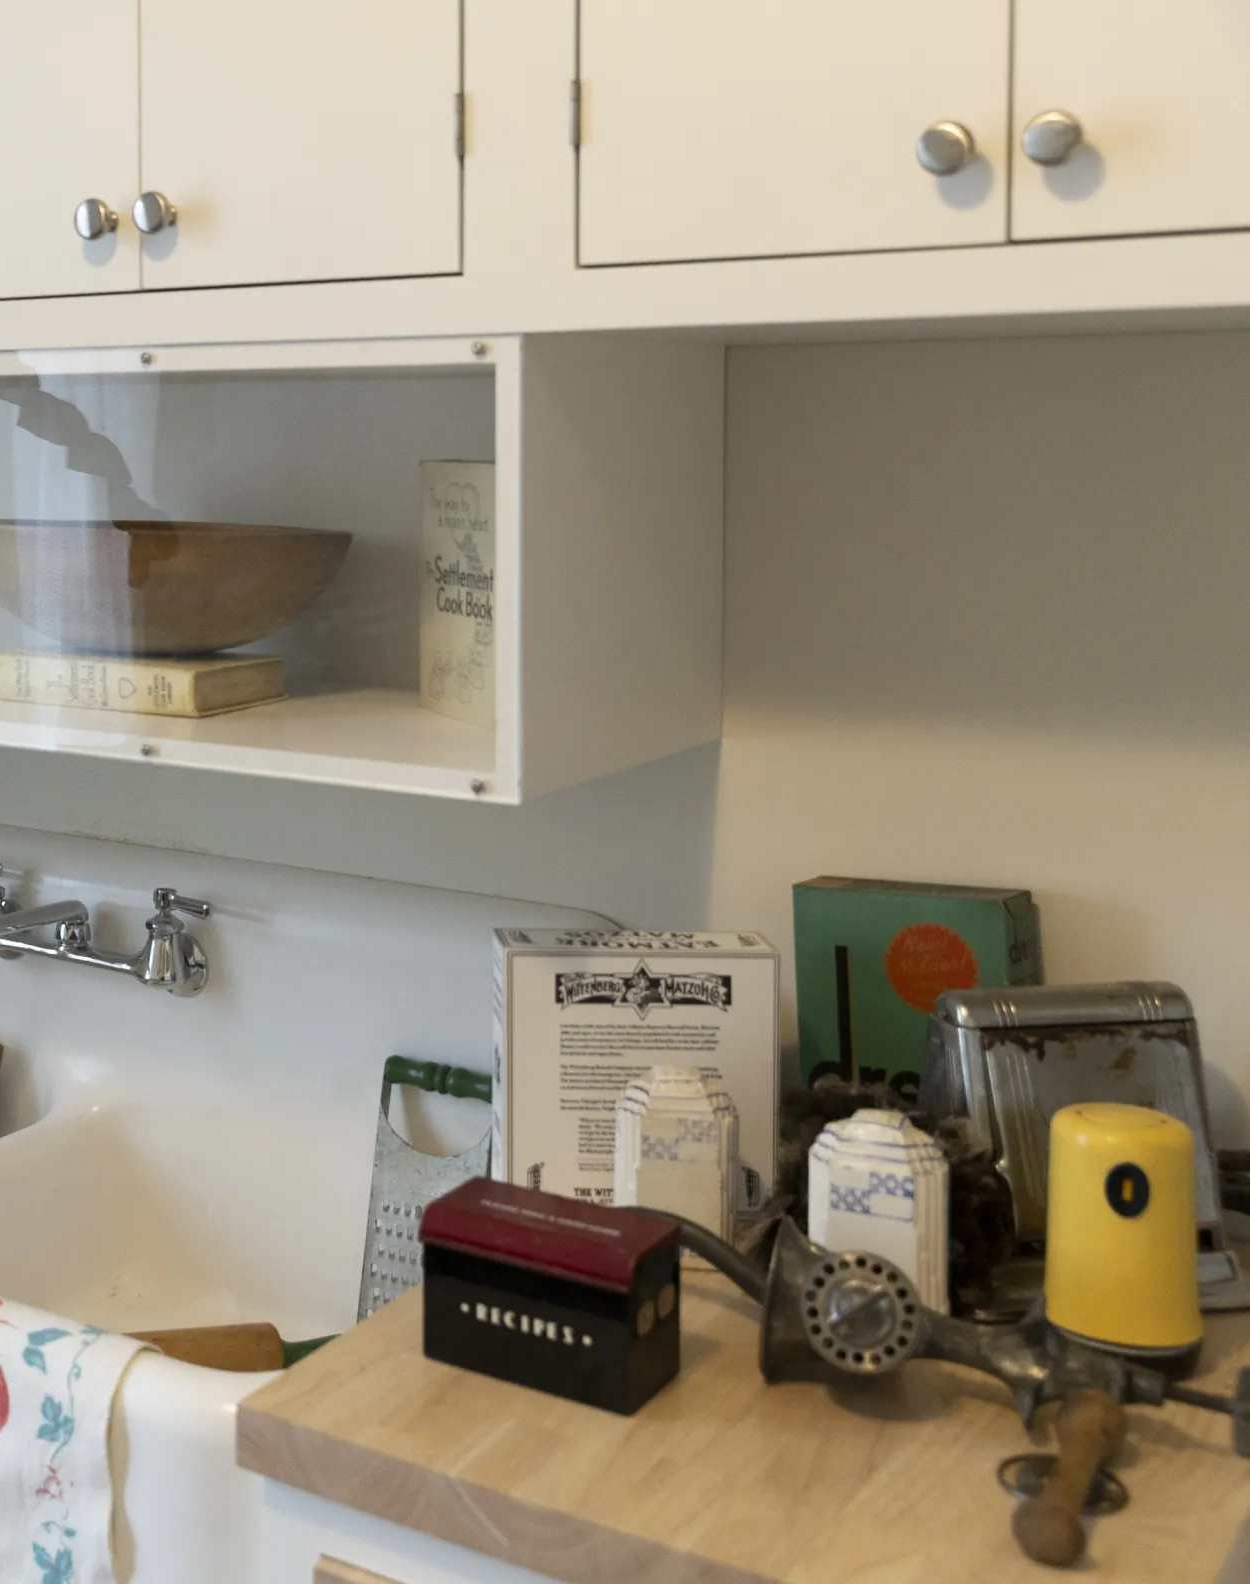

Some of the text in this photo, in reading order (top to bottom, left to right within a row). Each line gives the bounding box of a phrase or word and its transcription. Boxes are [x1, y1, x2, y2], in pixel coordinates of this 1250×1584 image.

[434, 556, 493, 592] Settlement
[436, 587, 493, 622] Cook Book
[80, 665, 96, 685] Book
[565, 977, 622, 1002] WITTENBERG
[664, 979, 708, 1000] MATZOH
[574, 1188, 614, 1196] THE WIT
[475, 1302, 576, 1346] RECIPES
